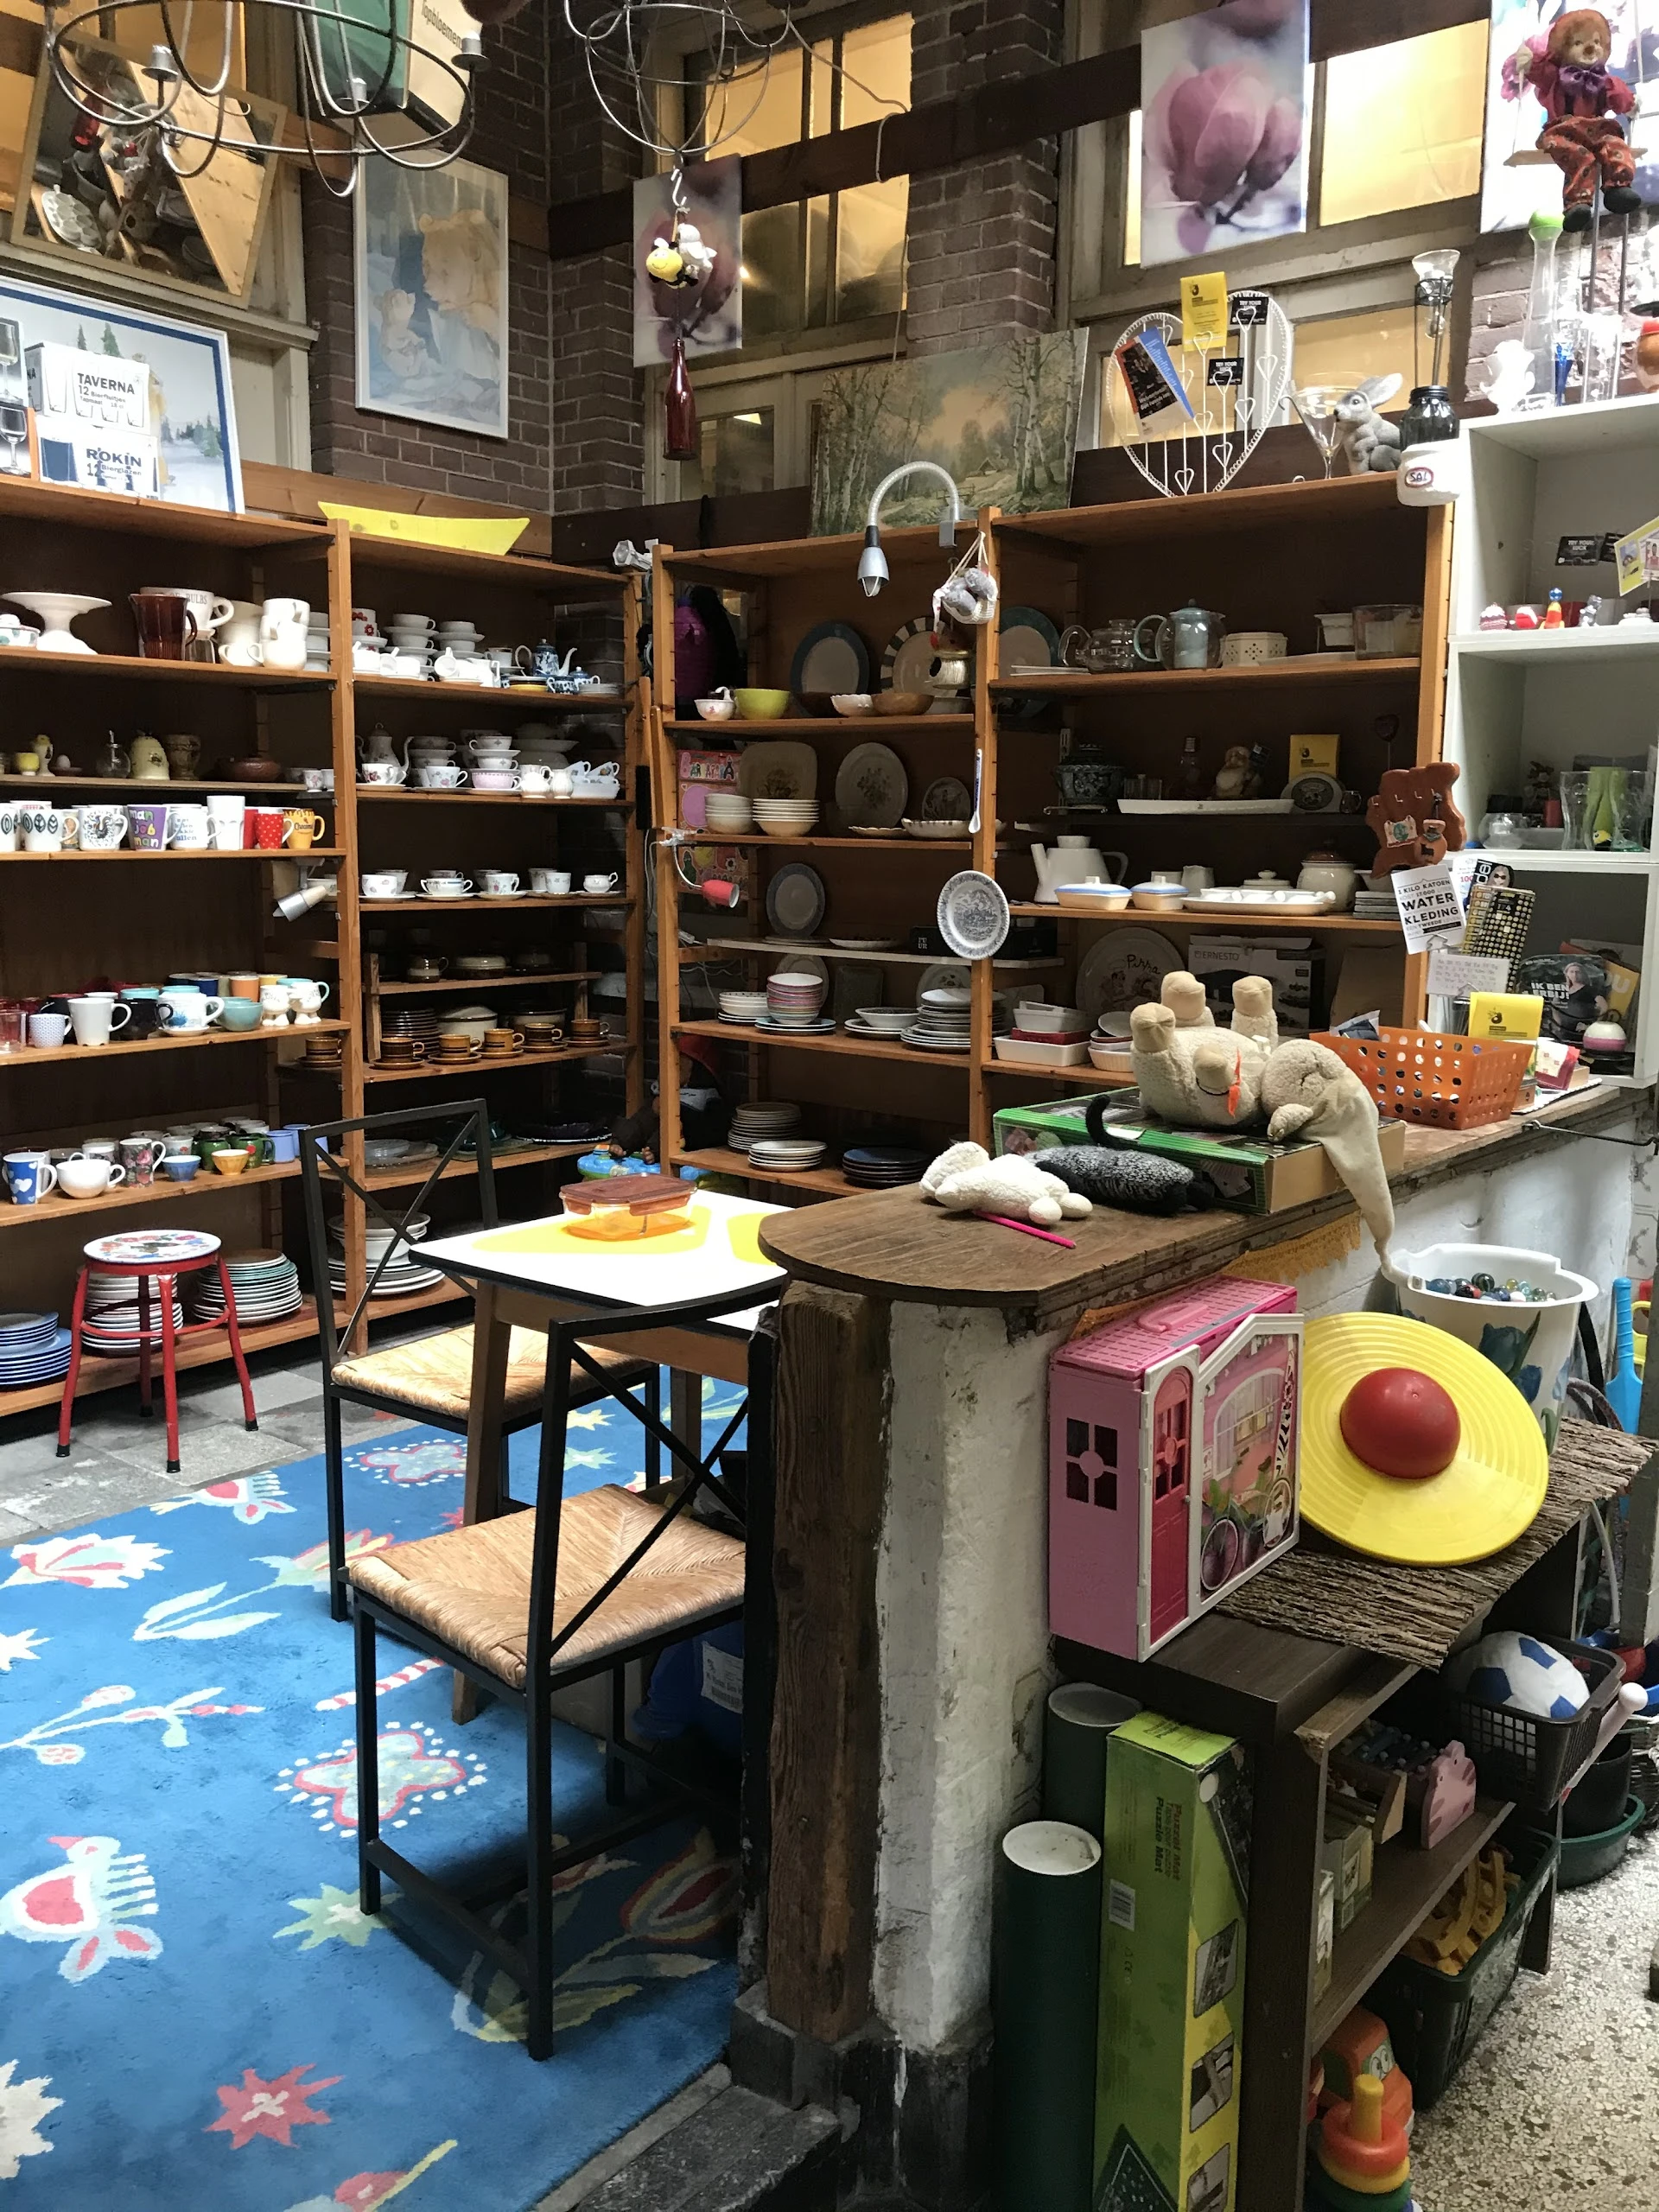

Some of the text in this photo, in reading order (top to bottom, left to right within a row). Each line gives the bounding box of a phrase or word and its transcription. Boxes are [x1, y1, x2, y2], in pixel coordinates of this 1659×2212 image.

[77, 372, 135, 395] TAVERNA
[79, 385, 89, 396] 12
[86, 448, 142, 467] ROKIN
[186, 593, 207, 604] BULBS
[129, 810, 154, 821] man
[134, 836, 159, 848] man
[1403, 885, 1421, 893] KILO
[1422, 880, 1451, 889] KATOEN
[1402, 893, 1455, 912] WATER
[1404, 906, 1459, 925] KLEDING
[1418, 919, 1442, 929] TWEEDE
[1203, 951, 1240, 961] ERNESTO
[1547, 983, 1570, 992] BEN
[1154, 1796, 1164, 1873] Puzzle Mat
